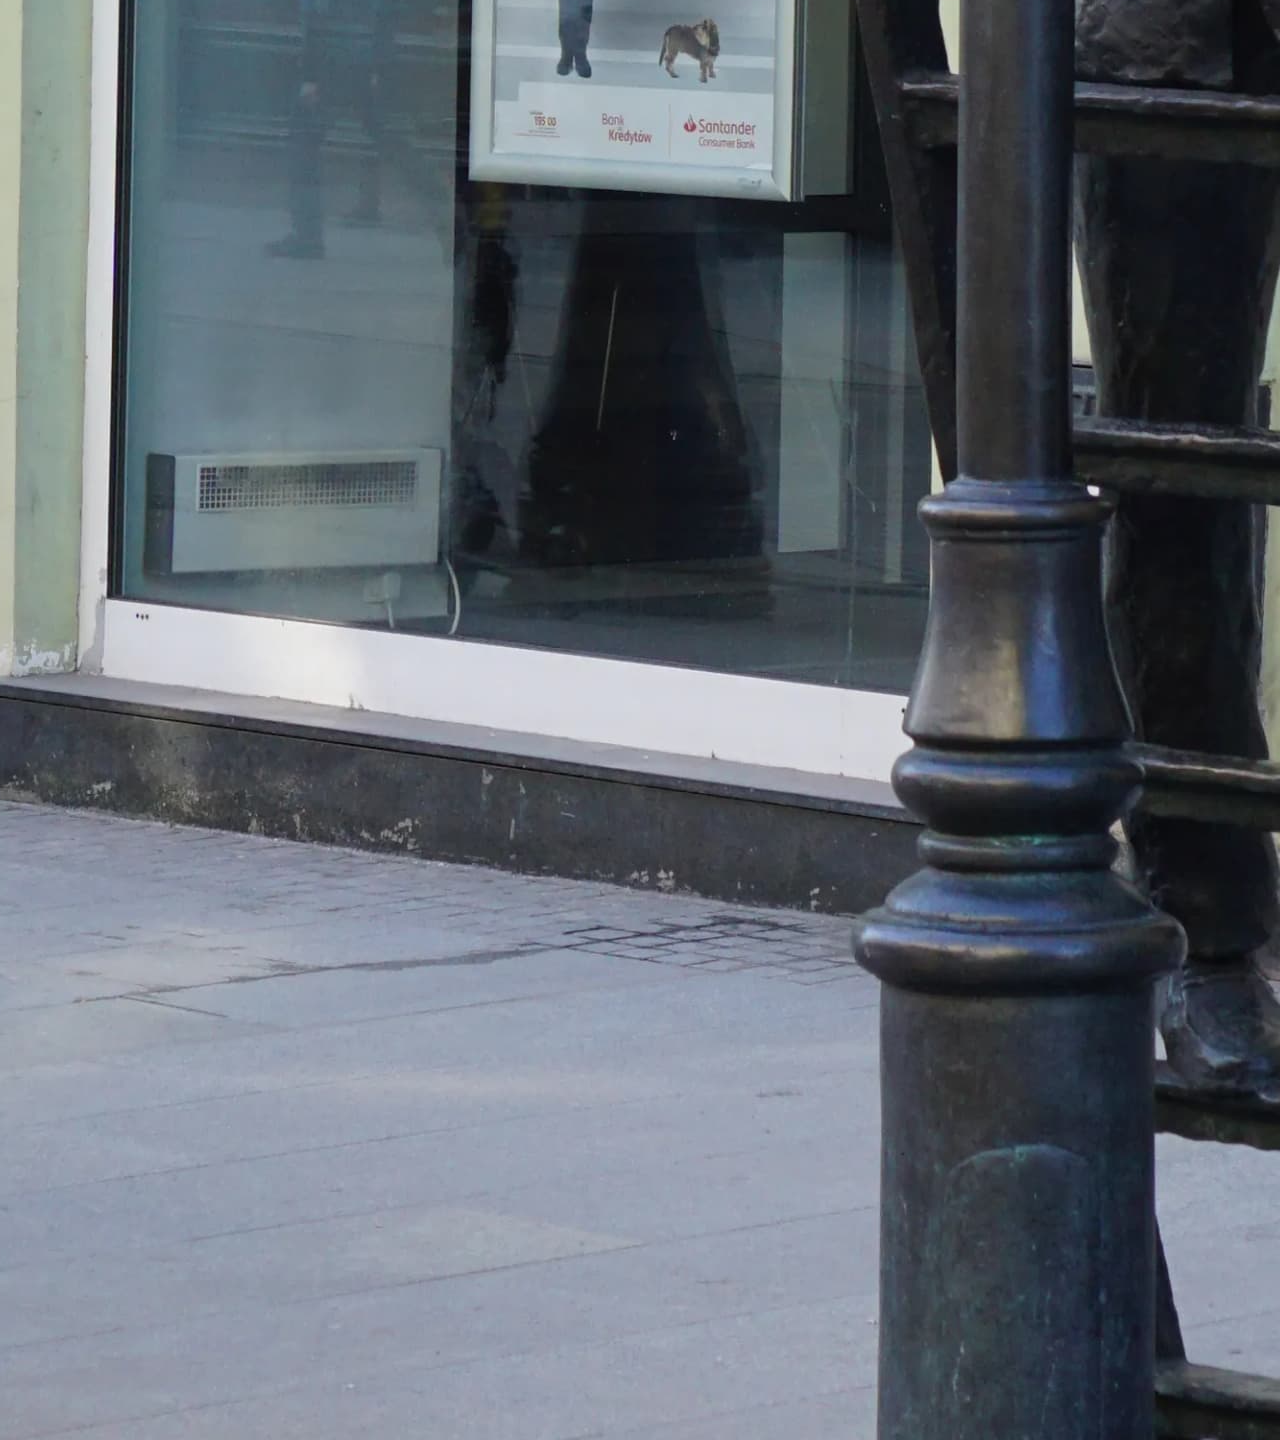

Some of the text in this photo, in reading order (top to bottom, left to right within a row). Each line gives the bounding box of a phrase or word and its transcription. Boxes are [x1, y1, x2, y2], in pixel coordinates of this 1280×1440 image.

[601, 112, 625, 126] Bank
[697, 118, 757, 136] Santander
[608, 129, 653, 145] Kredytów
[697, 136, 756, 149] Consumer Bank
